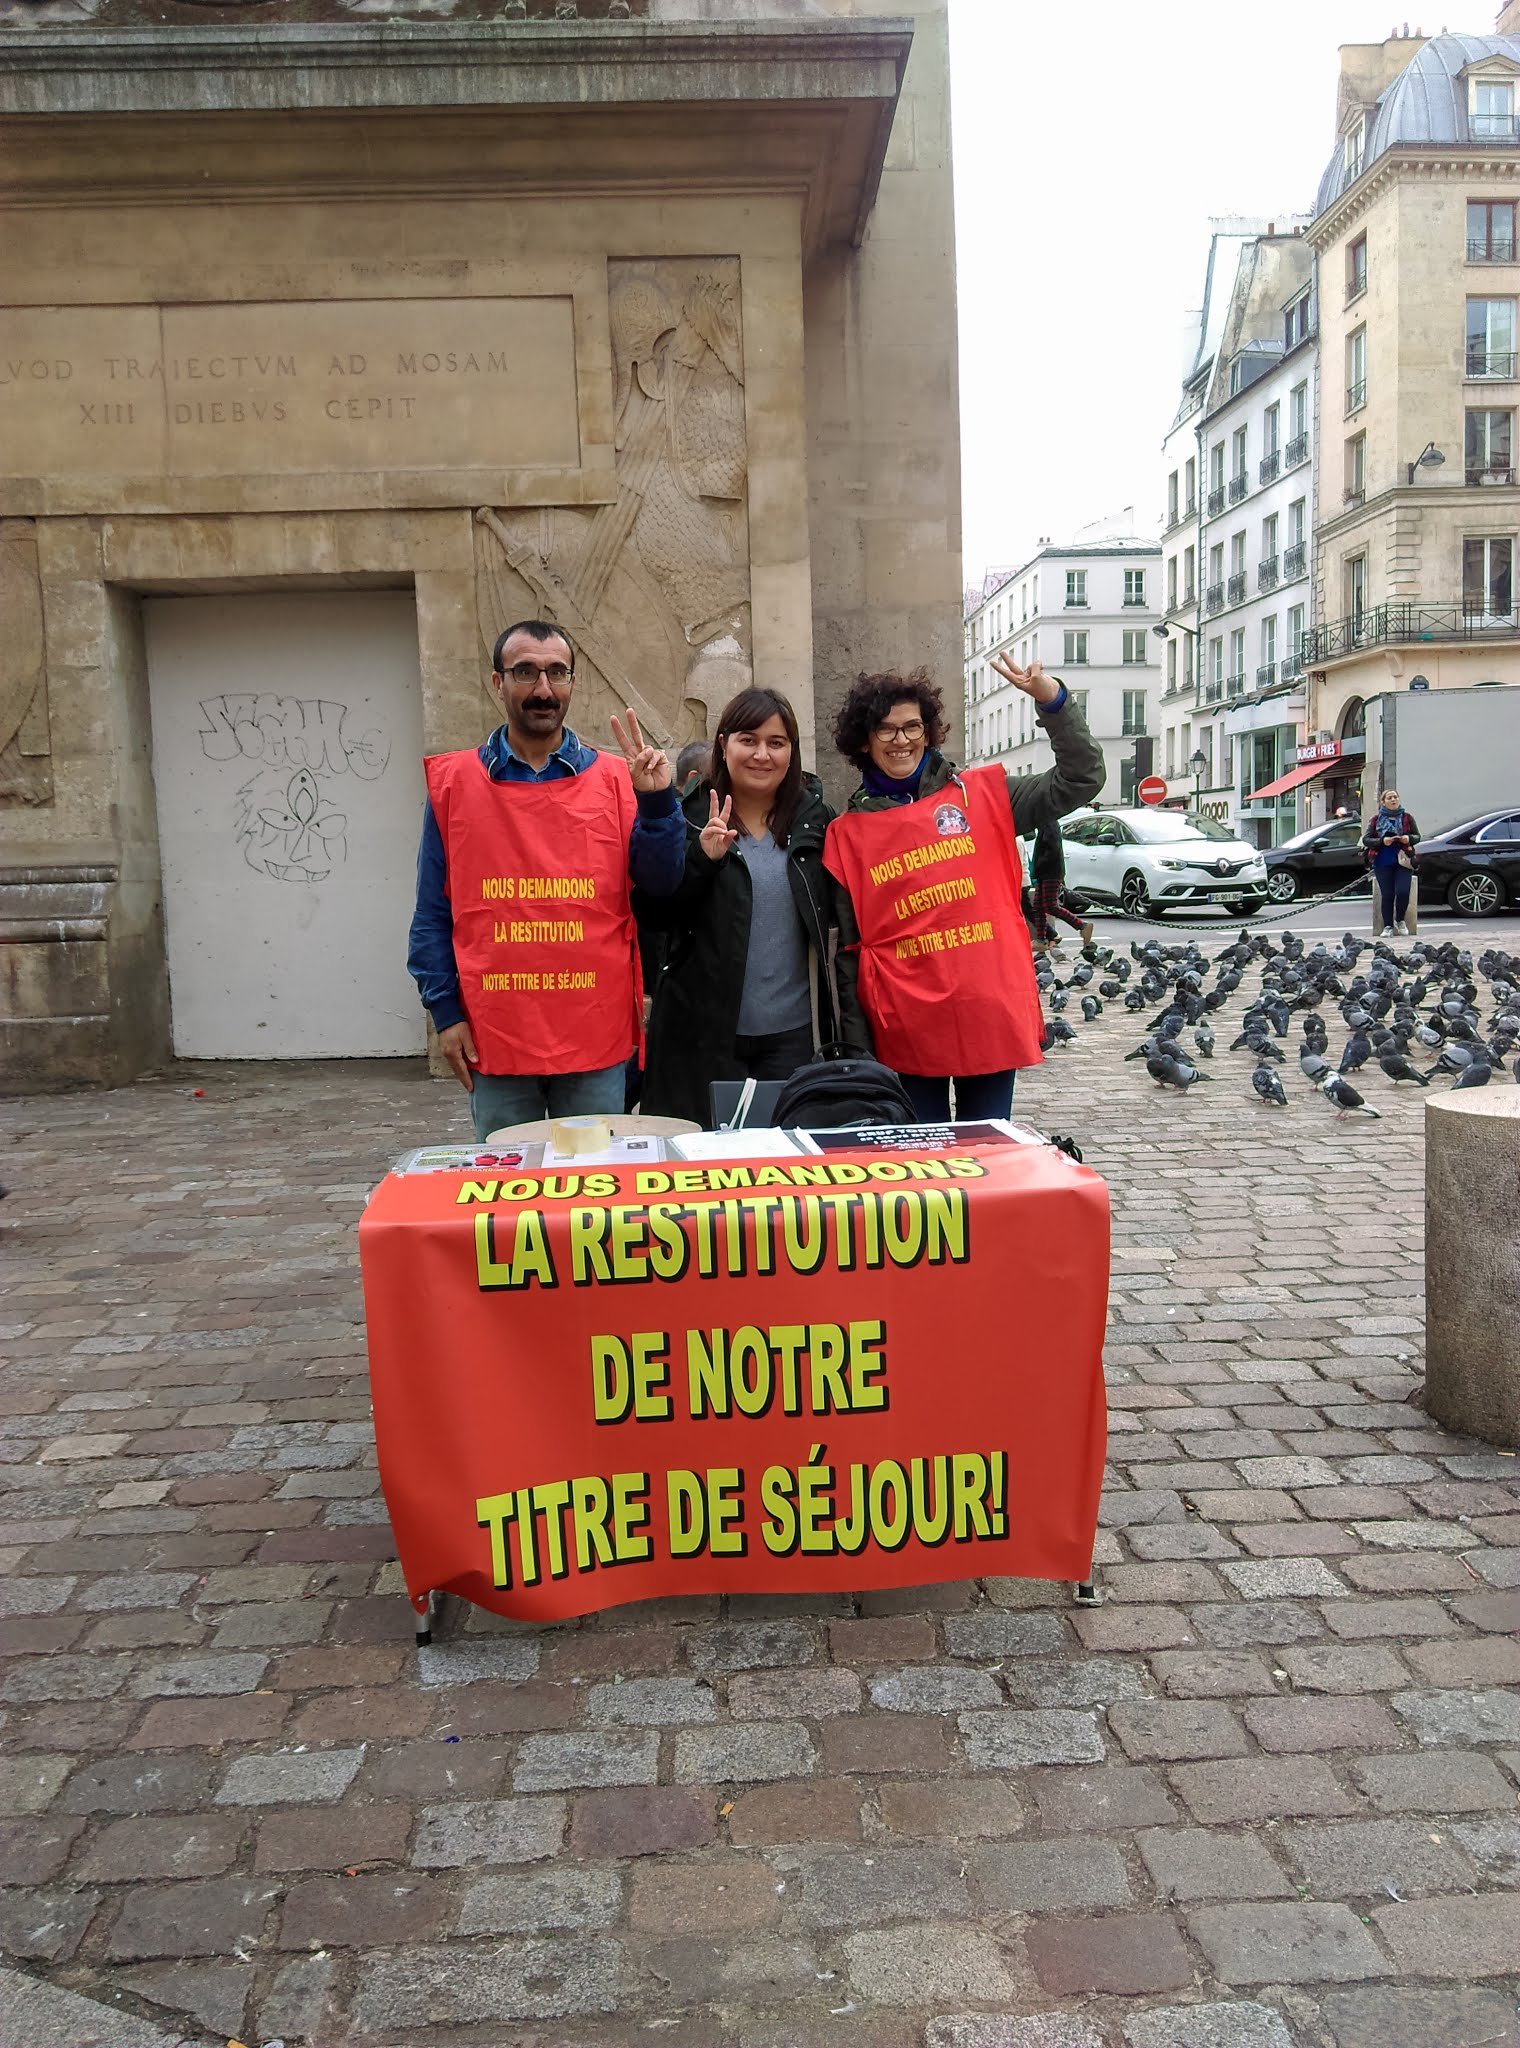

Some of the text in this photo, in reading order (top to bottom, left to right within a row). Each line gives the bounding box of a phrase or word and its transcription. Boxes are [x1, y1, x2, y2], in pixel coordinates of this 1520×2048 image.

[0, 352, 509, 384] VOD TRAIECTVM AD MOSAM
[80, 397, 417, 425] XIII DIEBVS CEPIT
[869, 835, 976, 886] NOUS DEMANDONS
[482, 877, 596, 899] NOUS DEMANDONS
[894, 876, 976, 920] LA RESTITUTION
[494, 920, 584, 943] LA RESTITUTION
[896, 921, 994, 959] NOTRE TITRE DE SÉJOUR!
[482, 969, 596, 991] NOTRE TITRE DE SÉJOUR!
[456, 1156, 986, 1204] NOUS DEMANDONS
[473, 1187, 969, 1290] LA RESTITUTION
[590, 1319, 888, 1423] DE NOTRE
[475, 1443, 1009, 1589] TITRE DE SÉJOUR!
